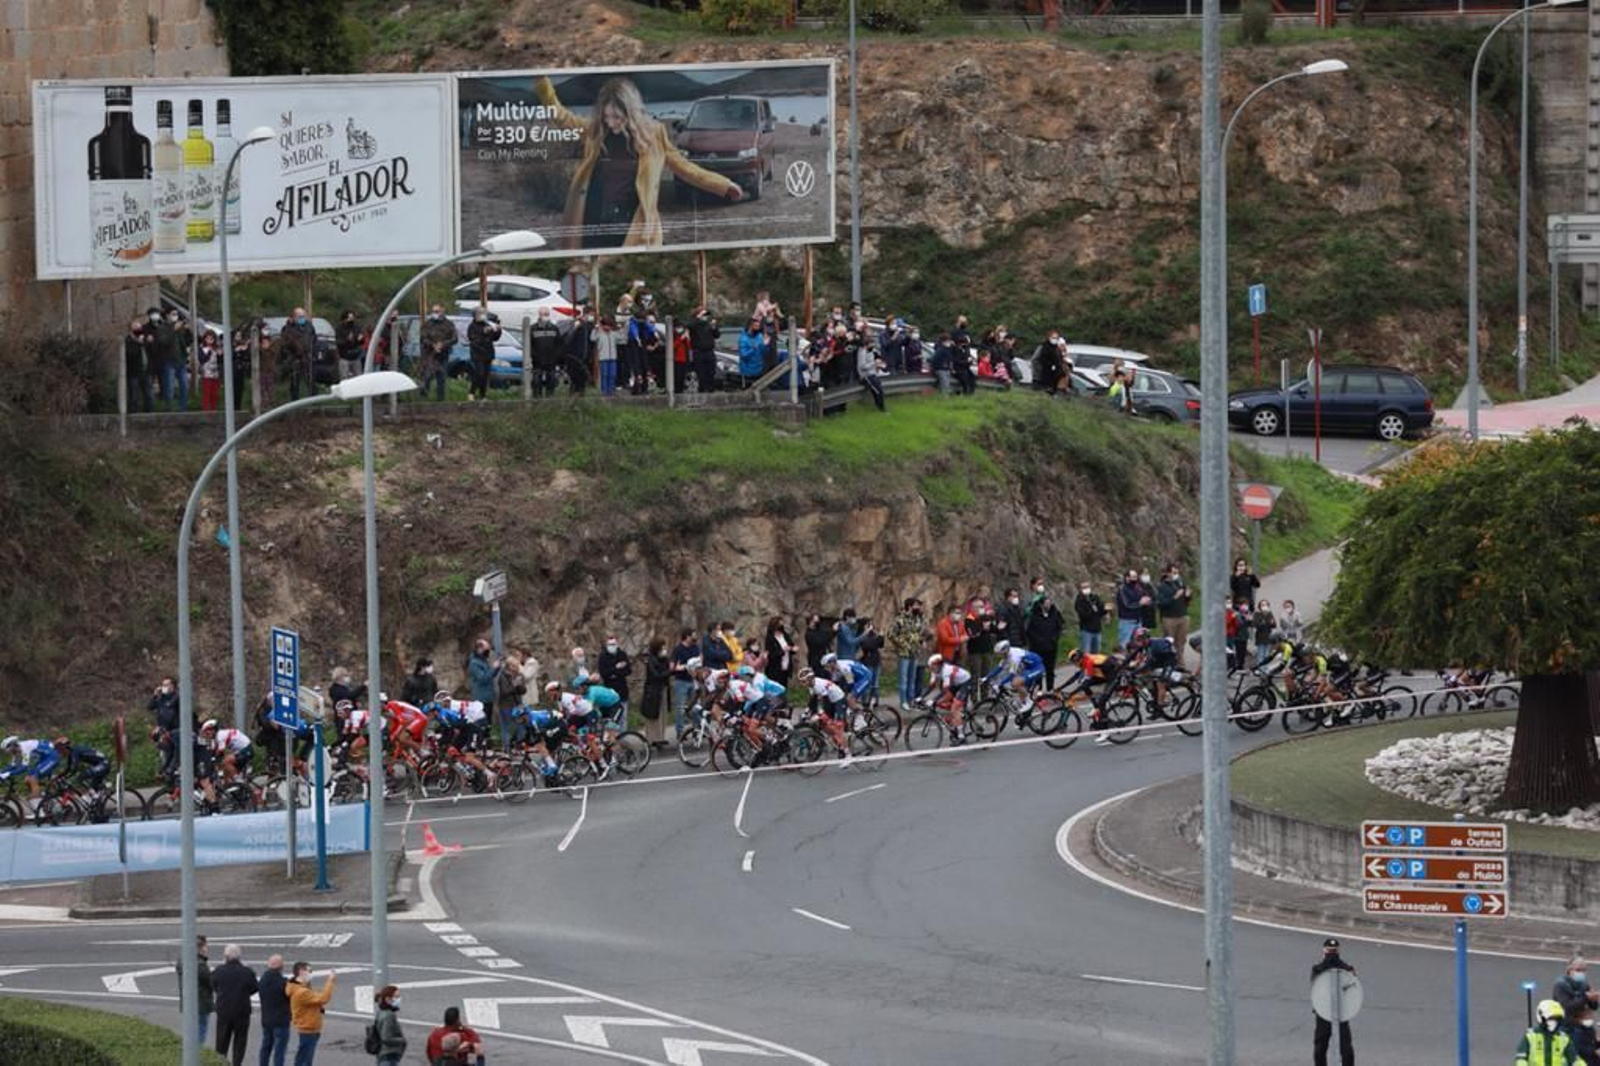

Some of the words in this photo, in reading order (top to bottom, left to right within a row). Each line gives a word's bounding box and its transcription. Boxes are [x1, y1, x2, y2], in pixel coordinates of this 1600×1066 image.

[476, 101, 558, 122] Multivan
[280, 120, 334, 151] QUIERES
[477, 127, 492, 137] Por
[494, 126, 526, 145] 330
[477, 149, 496, 160] Con
[498, 149, 512, 163] My
[513, 148, 549, 162] Renting
[329, 160, 343, 176] EL
[262, 156, 416, 236] AFILADOR
[1468, 829, 1501, 838] termas
[1450, 838, 1463, 846] de
[1457, 871, 1470, 879] do
[1367, 891, 1400, 901] termas
